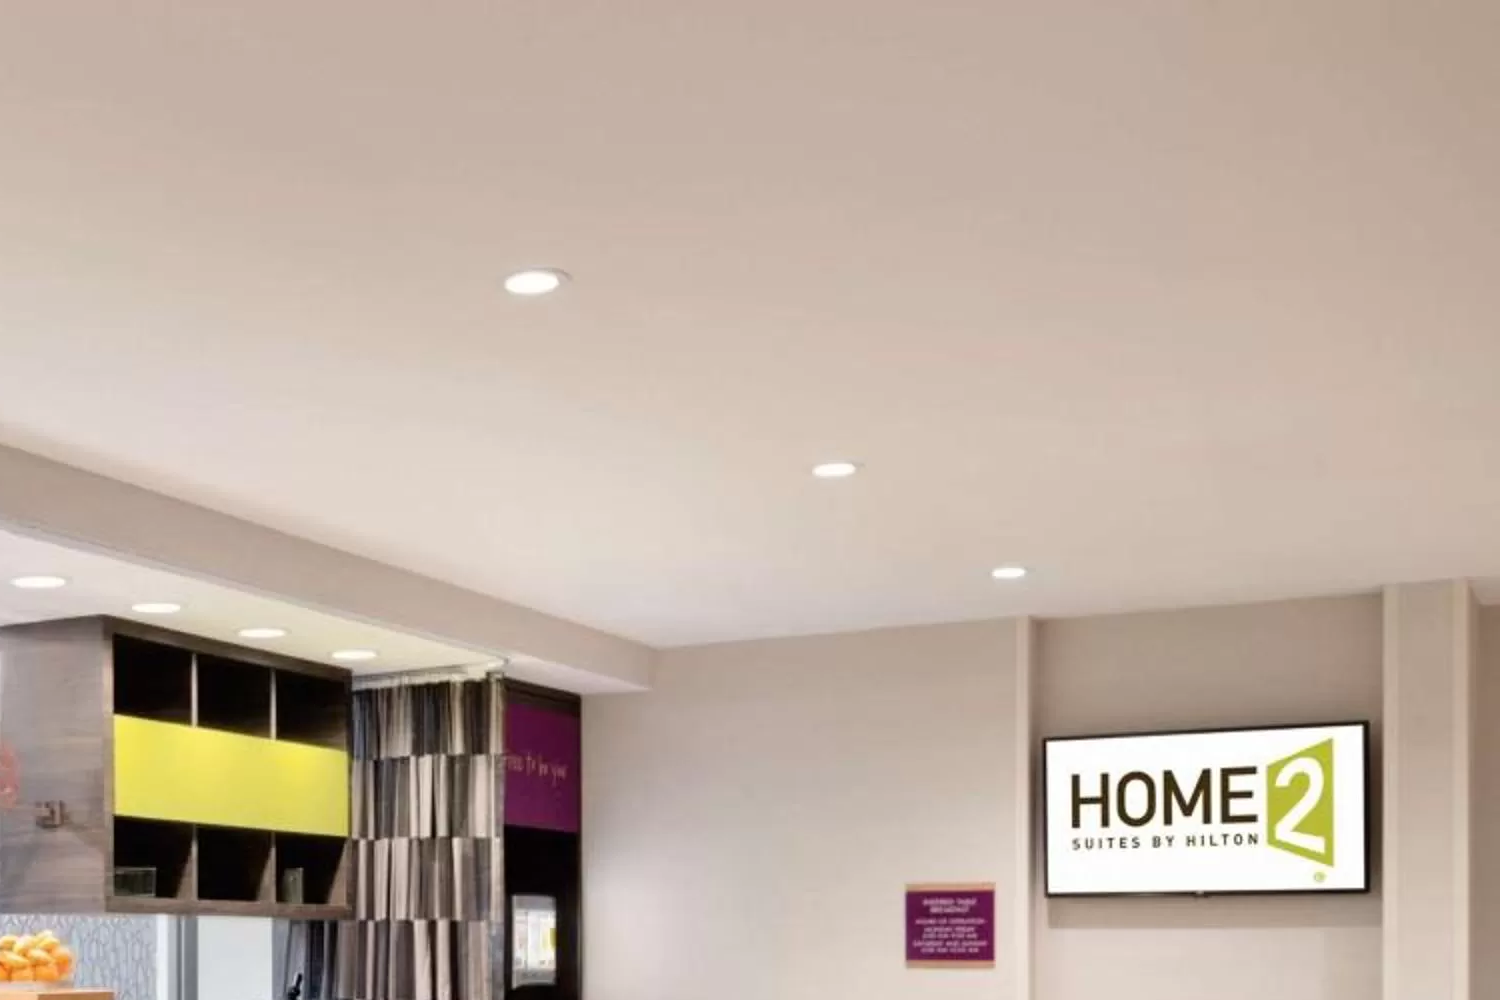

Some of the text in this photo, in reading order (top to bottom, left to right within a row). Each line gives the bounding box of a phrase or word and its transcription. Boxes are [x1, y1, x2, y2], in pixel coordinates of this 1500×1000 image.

[1071, 766, 1258, 829] HOME
[1071, 833, 1259, 851] SUITES BY HILTON
